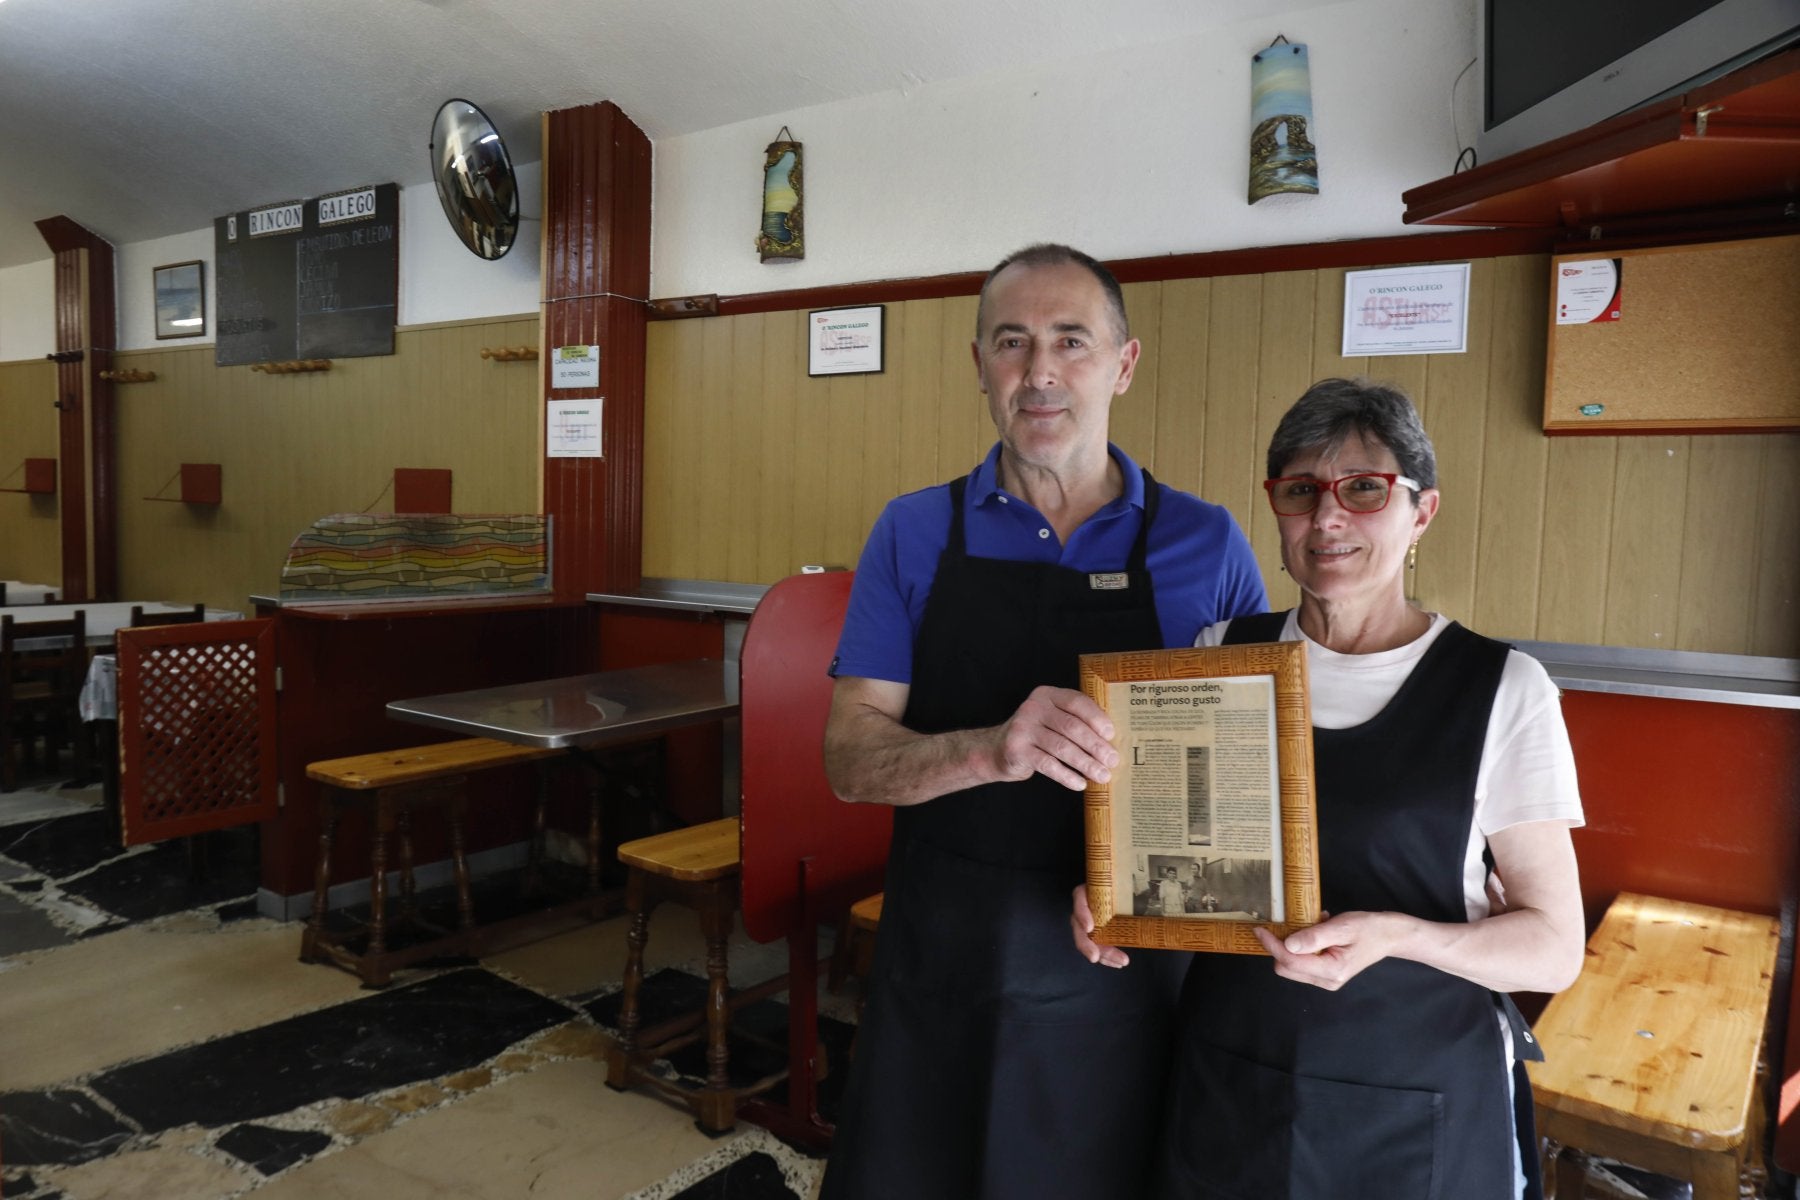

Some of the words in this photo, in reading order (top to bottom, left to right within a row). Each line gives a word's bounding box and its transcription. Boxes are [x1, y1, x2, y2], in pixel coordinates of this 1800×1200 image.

[251, 207, 301, 233] RINCON
[320, 192, 375, 221] GALEGO
[352, 228, 366, 246] DE
[1377, 286, 1408, 294] RINCON
[1409, 284, 1443, 292] GALEGO
[1130, 684, 1146, 694] Por
[1148, 683, 1189, 696] riguroso
[1191, 682, 1224, 693] orden,
[1130, 697, 1148, 706] con
[1150, 695, 1191, 707] riguroso
[1192, 695, 1221, 708] gusto
